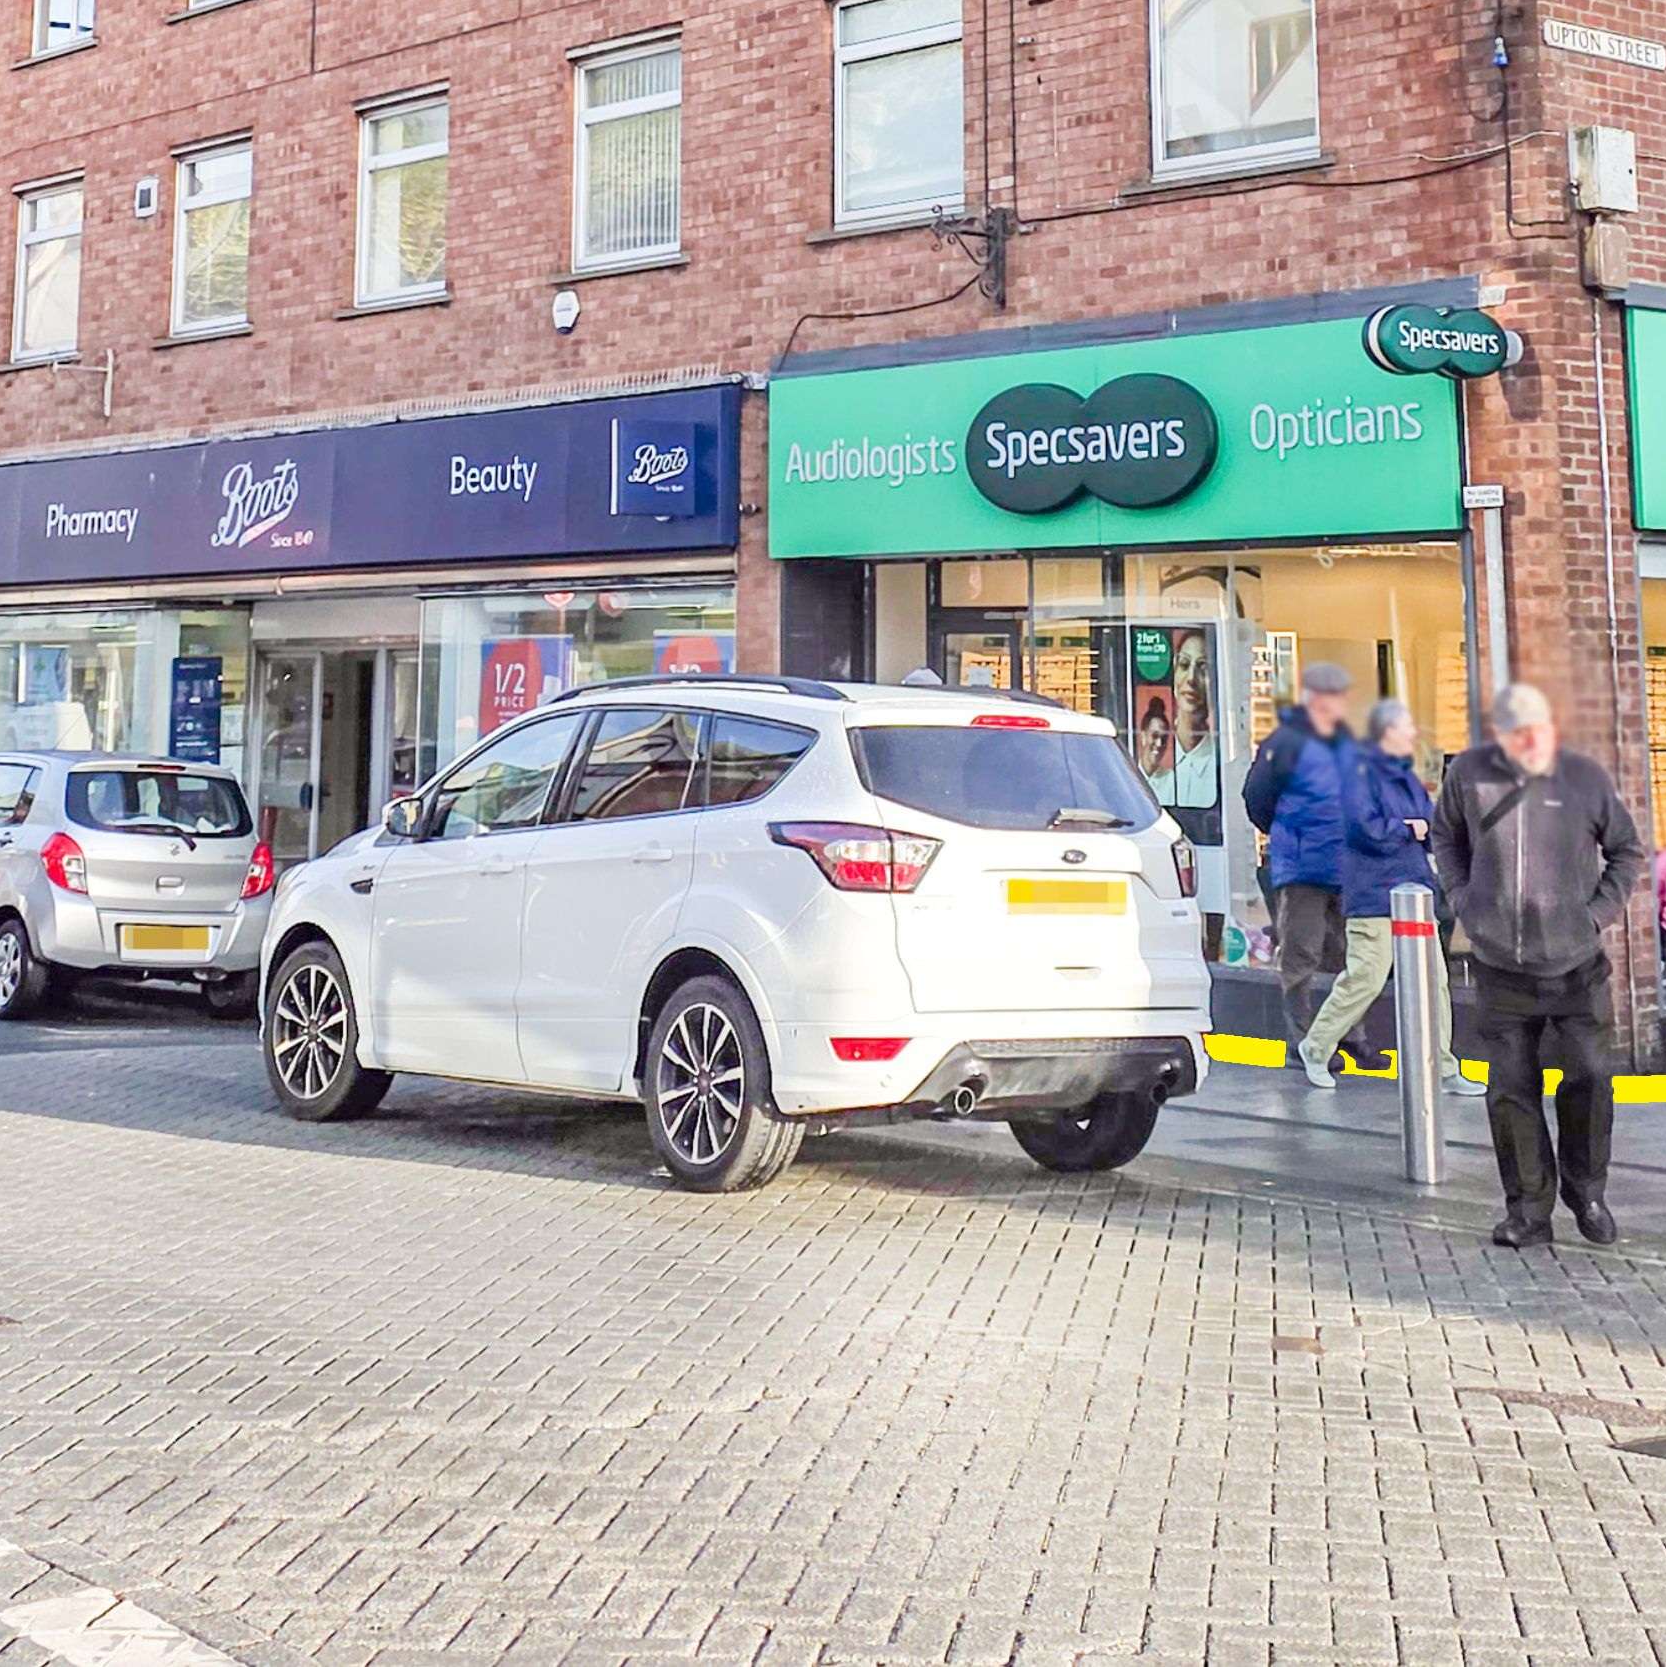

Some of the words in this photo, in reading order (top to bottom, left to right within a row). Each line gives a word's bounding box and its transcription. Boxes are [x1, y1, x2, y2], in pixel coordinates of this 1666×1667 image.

[1550, 24, 1601, 51] UPTON
[1608, 37, 1661, 65] STREET
[1398, 321, 1499, 354] Specsavers
[1250, 395, 1422, 460] Opticians
[627, 444, 688, 485] Boots
[784, 433, 957, 488] Audiologists
[985, 419, 1185, 478] Specsavers
[450, 455, 537, 502] Beauty
[46, 504, 138, 543] Pharmacy
[211, 458, 299, 548] Boots
[1170, 598, 1200, 610] Hers
[494, 662, 526, 695] 1/2
[494, 696, 525, 707] PRICE
